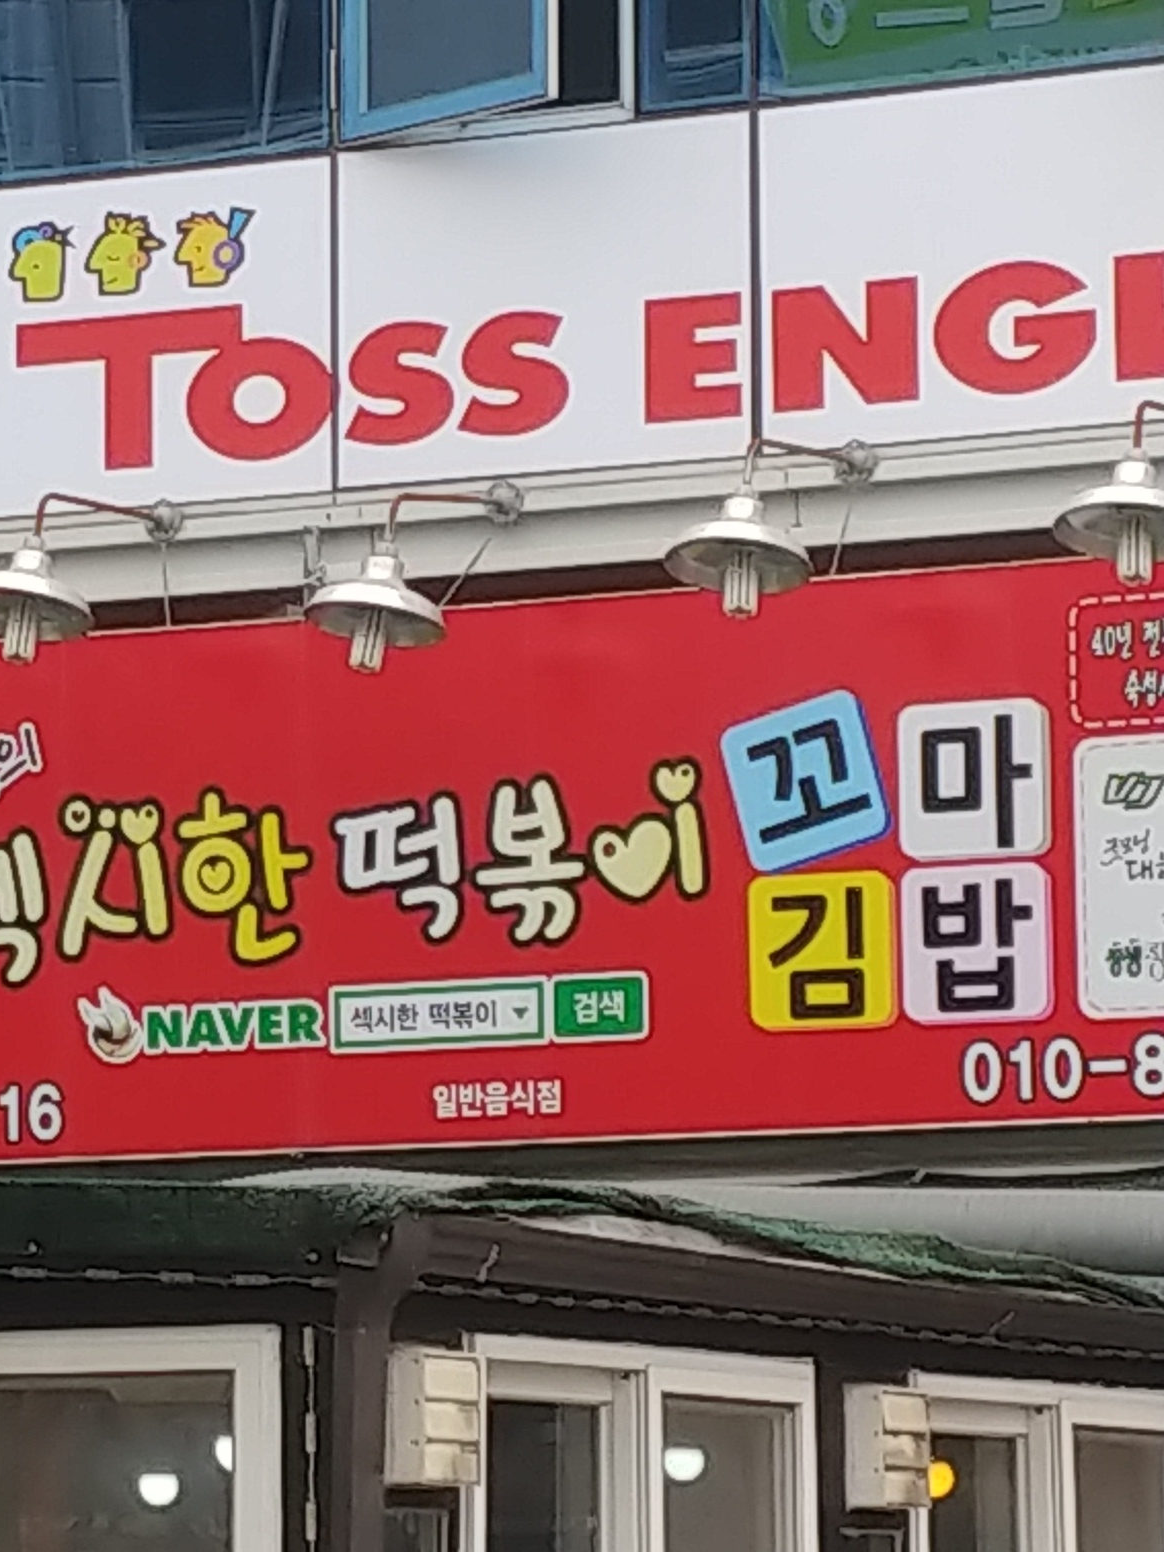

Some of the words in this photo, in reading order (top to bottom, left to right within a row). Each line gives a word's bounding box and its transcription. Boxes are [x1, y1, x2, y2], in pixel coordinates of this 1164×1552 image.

[16, 304, 571, 471] TOSS
[744, 712, 1034, 850] 꼬마
[334, 755, 711, 948] 떡볶이
[768, 876, 1034, 1020] 김밥
[142, 1000, 326, 1052] NAVER
[350, 1003, 419, 1034] 섹시한
[428, 999, 498, 1030] 떡볶이
[573, 989, 626, 1025] 검색
[431, 1078, 564, 1121] 일반음식점
[962, 1034, 1164, 1106] 010-8
